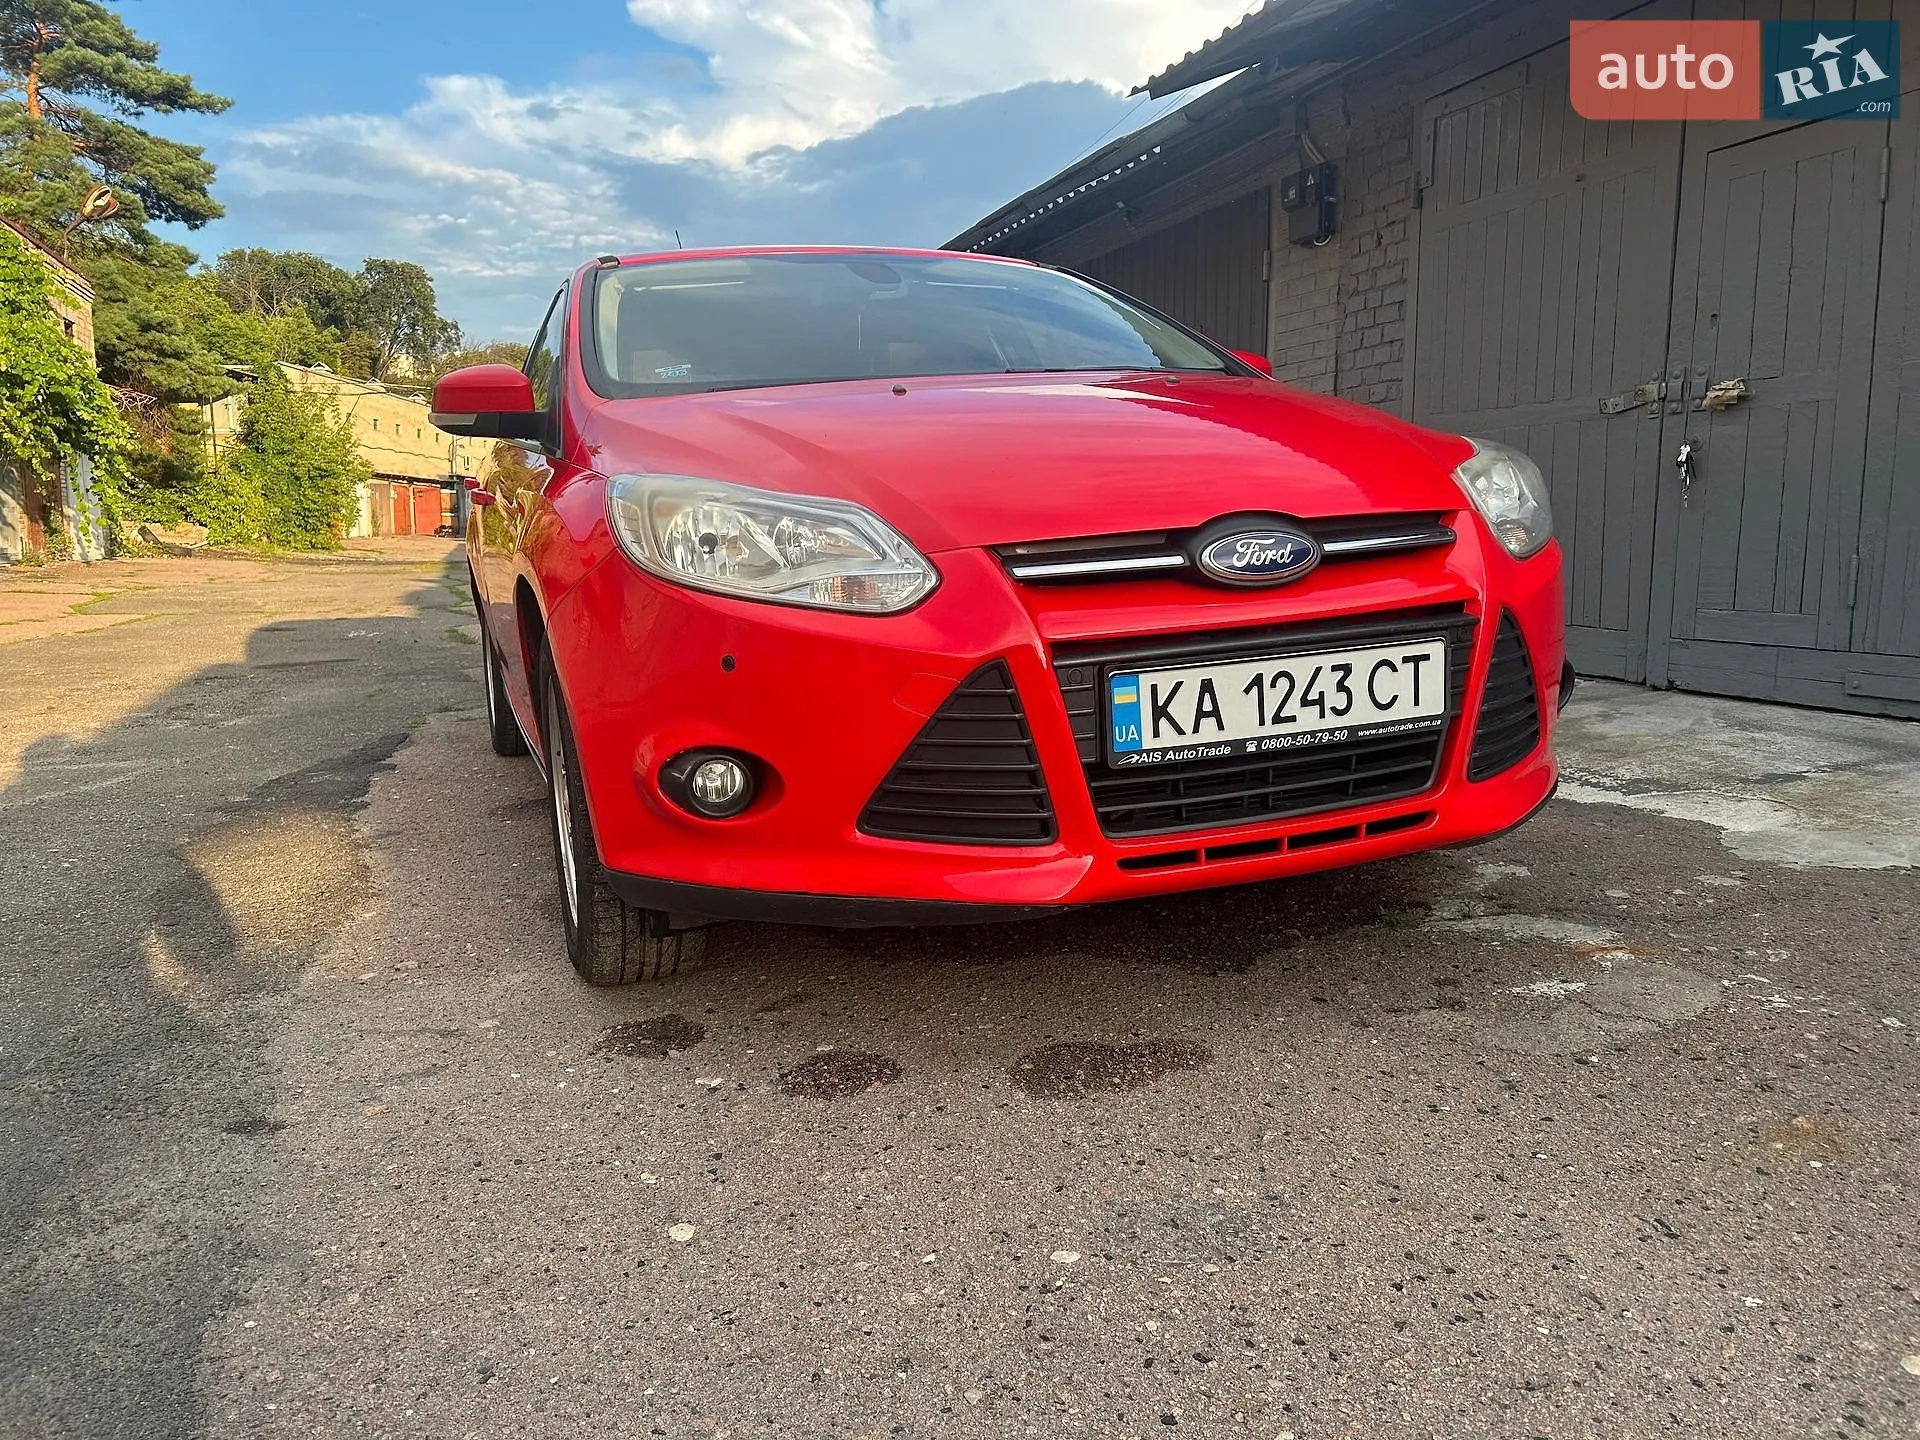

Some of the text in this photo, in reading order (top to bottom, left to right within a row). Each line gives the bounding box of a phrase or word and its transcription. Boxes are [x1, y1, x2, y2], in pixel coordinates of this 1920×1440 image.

[1232, 538, 1294, 568] Ford
[1150, 653, 1431, 739] KA 1243 CT
[1115, 725, 1139, 743] UA
[1138, 718, 1442, 764] AIS AutoTrade 0800-50-79-50 www.autotrade.com.ua
